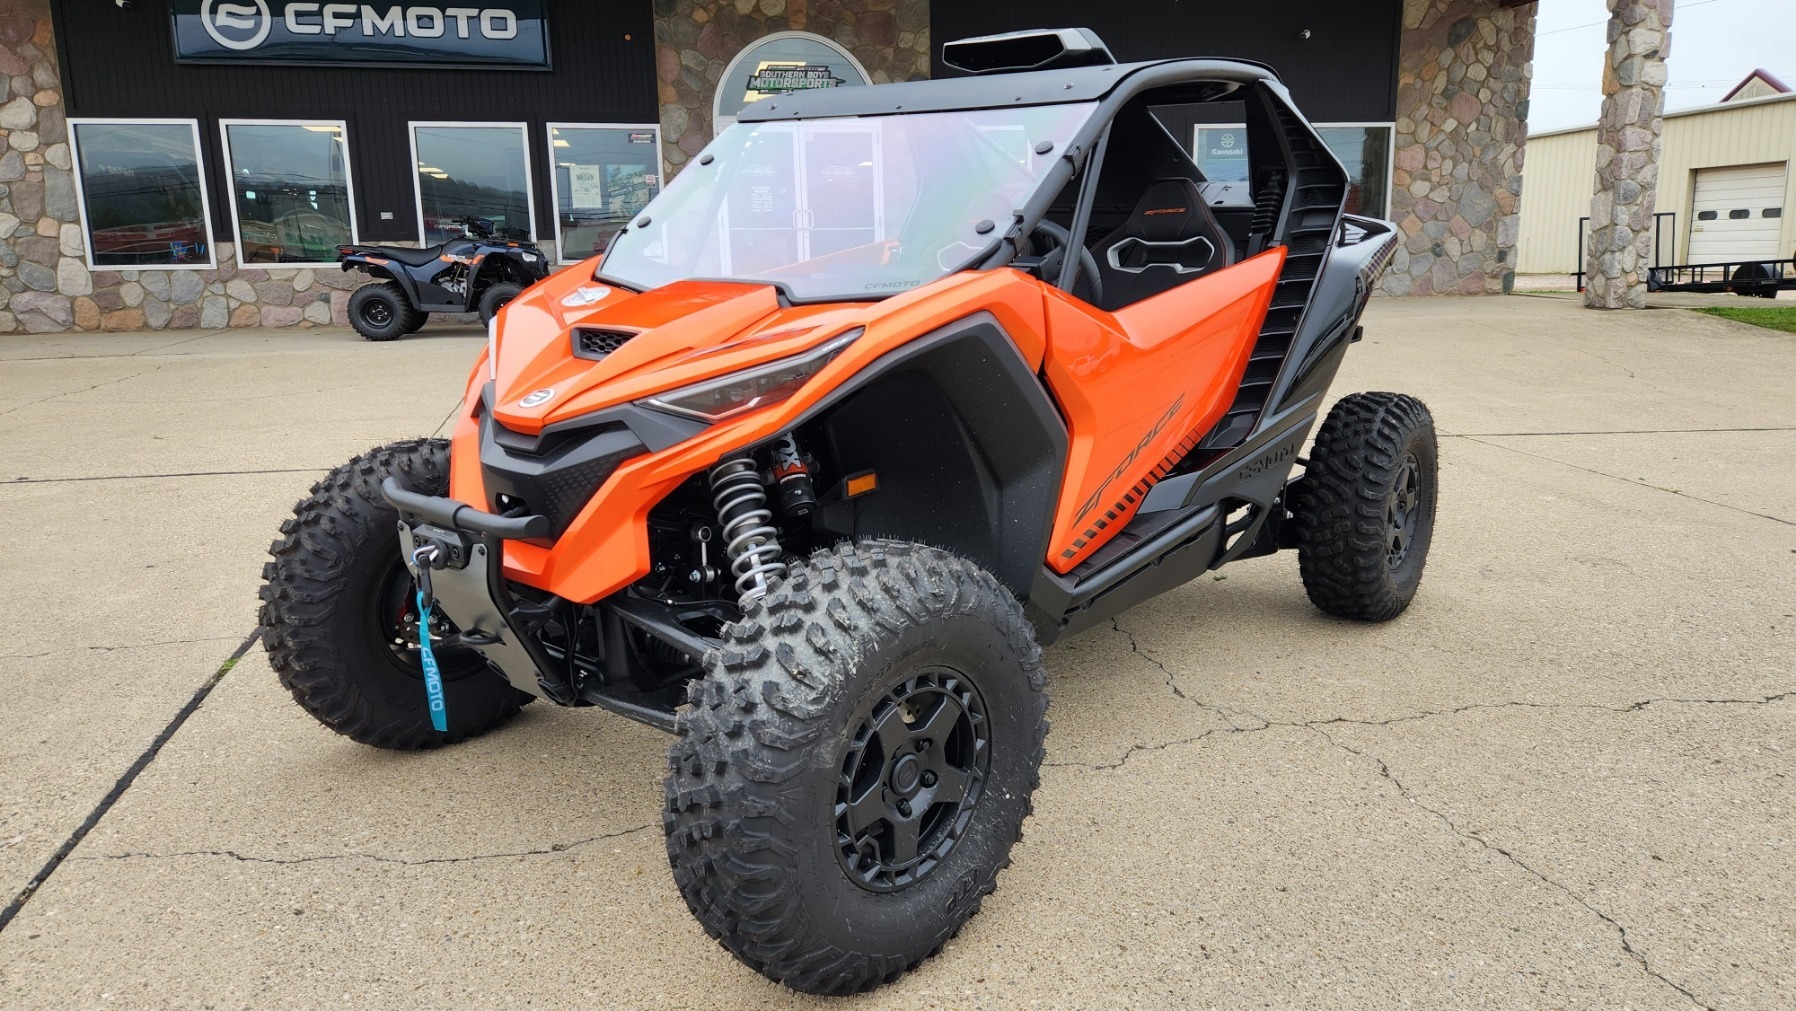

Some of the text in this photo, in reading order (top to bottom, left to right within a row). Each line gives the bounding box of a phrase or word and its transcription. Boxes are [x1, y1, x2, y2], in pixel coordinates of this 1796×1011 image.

[285, 2, 518, 40] CFMOTO
[750, 78, 837, 88] MOTORSPORTS
[760, 71, 830, 79] SOUTHERN BOYS
[864, 280, 920, 290] CFMOTO
[775, 431, 802, 471] OX
[421, 647, 444, 711] CFMOTO
